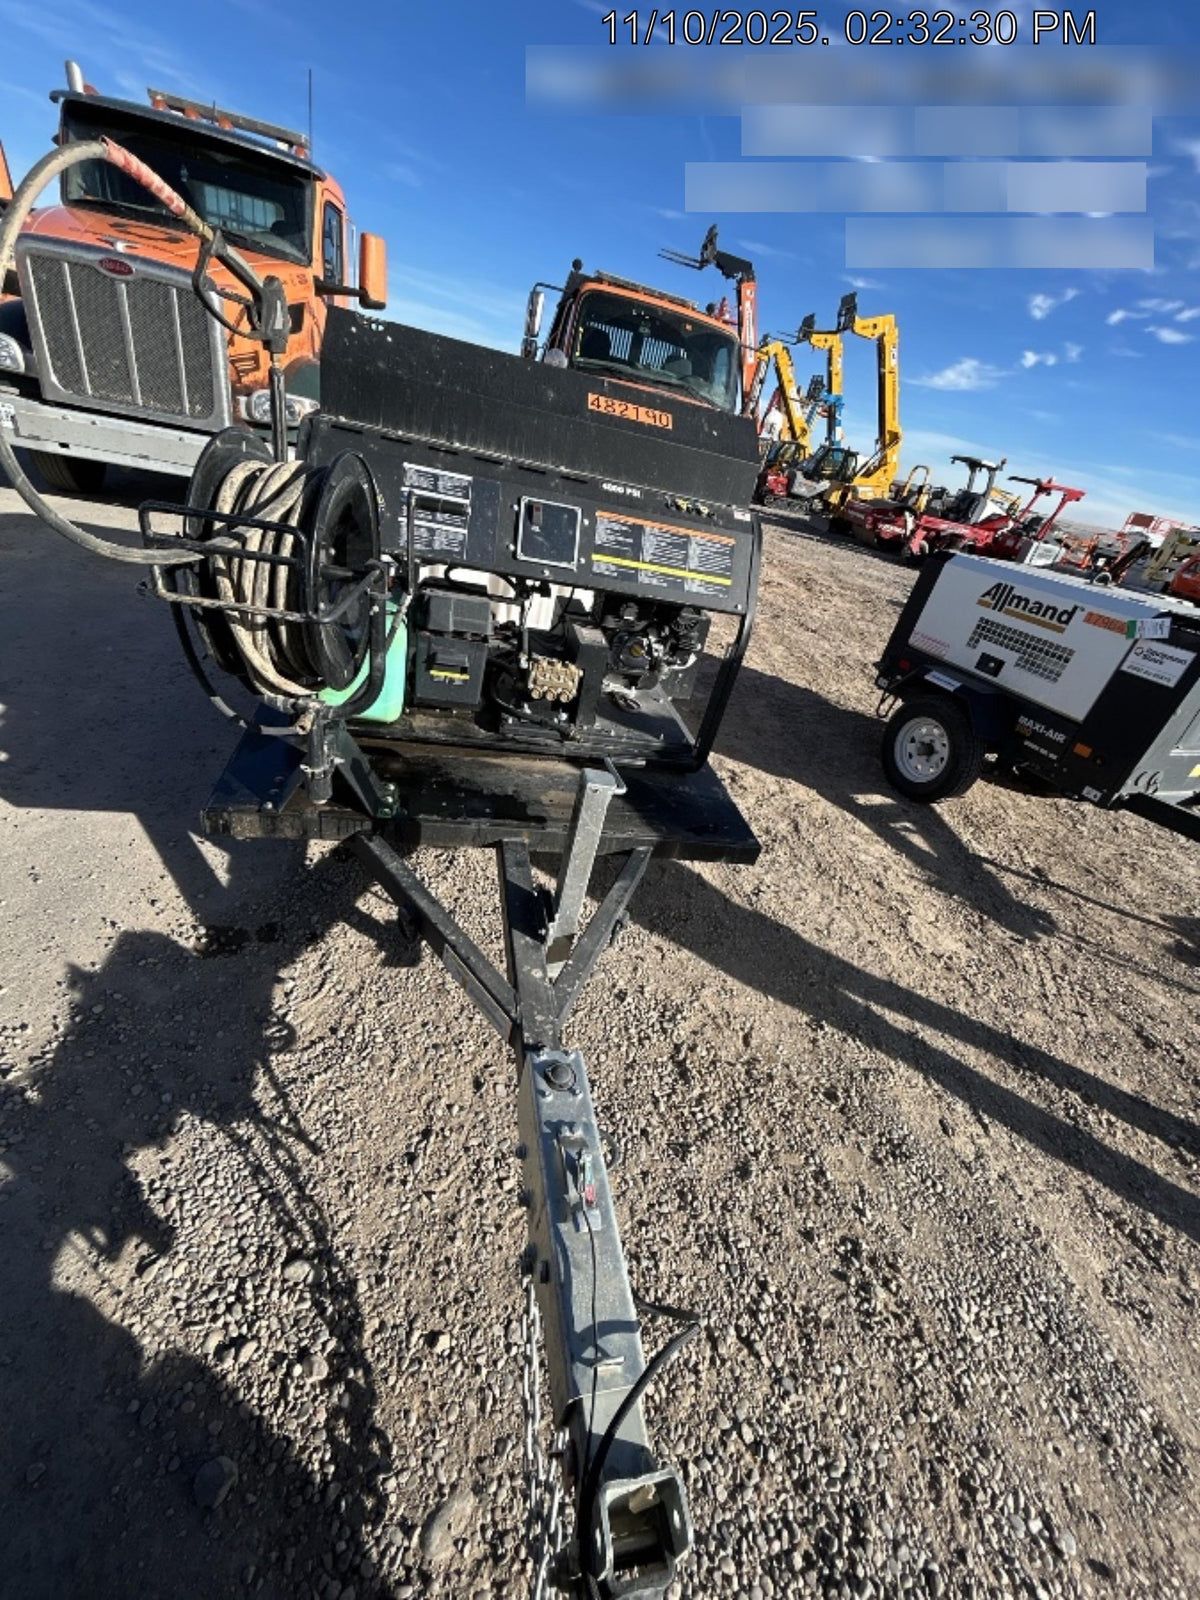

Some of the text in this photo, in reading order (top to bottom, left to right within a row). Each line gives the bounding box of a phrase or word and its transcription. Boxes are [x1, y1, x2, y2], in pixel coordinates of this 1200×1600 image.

[590, 395, 669, 428] 482190
[980, 582, 1079, 626] Allmand
[1017, 714, 1067, 744] MAXI-AIR
